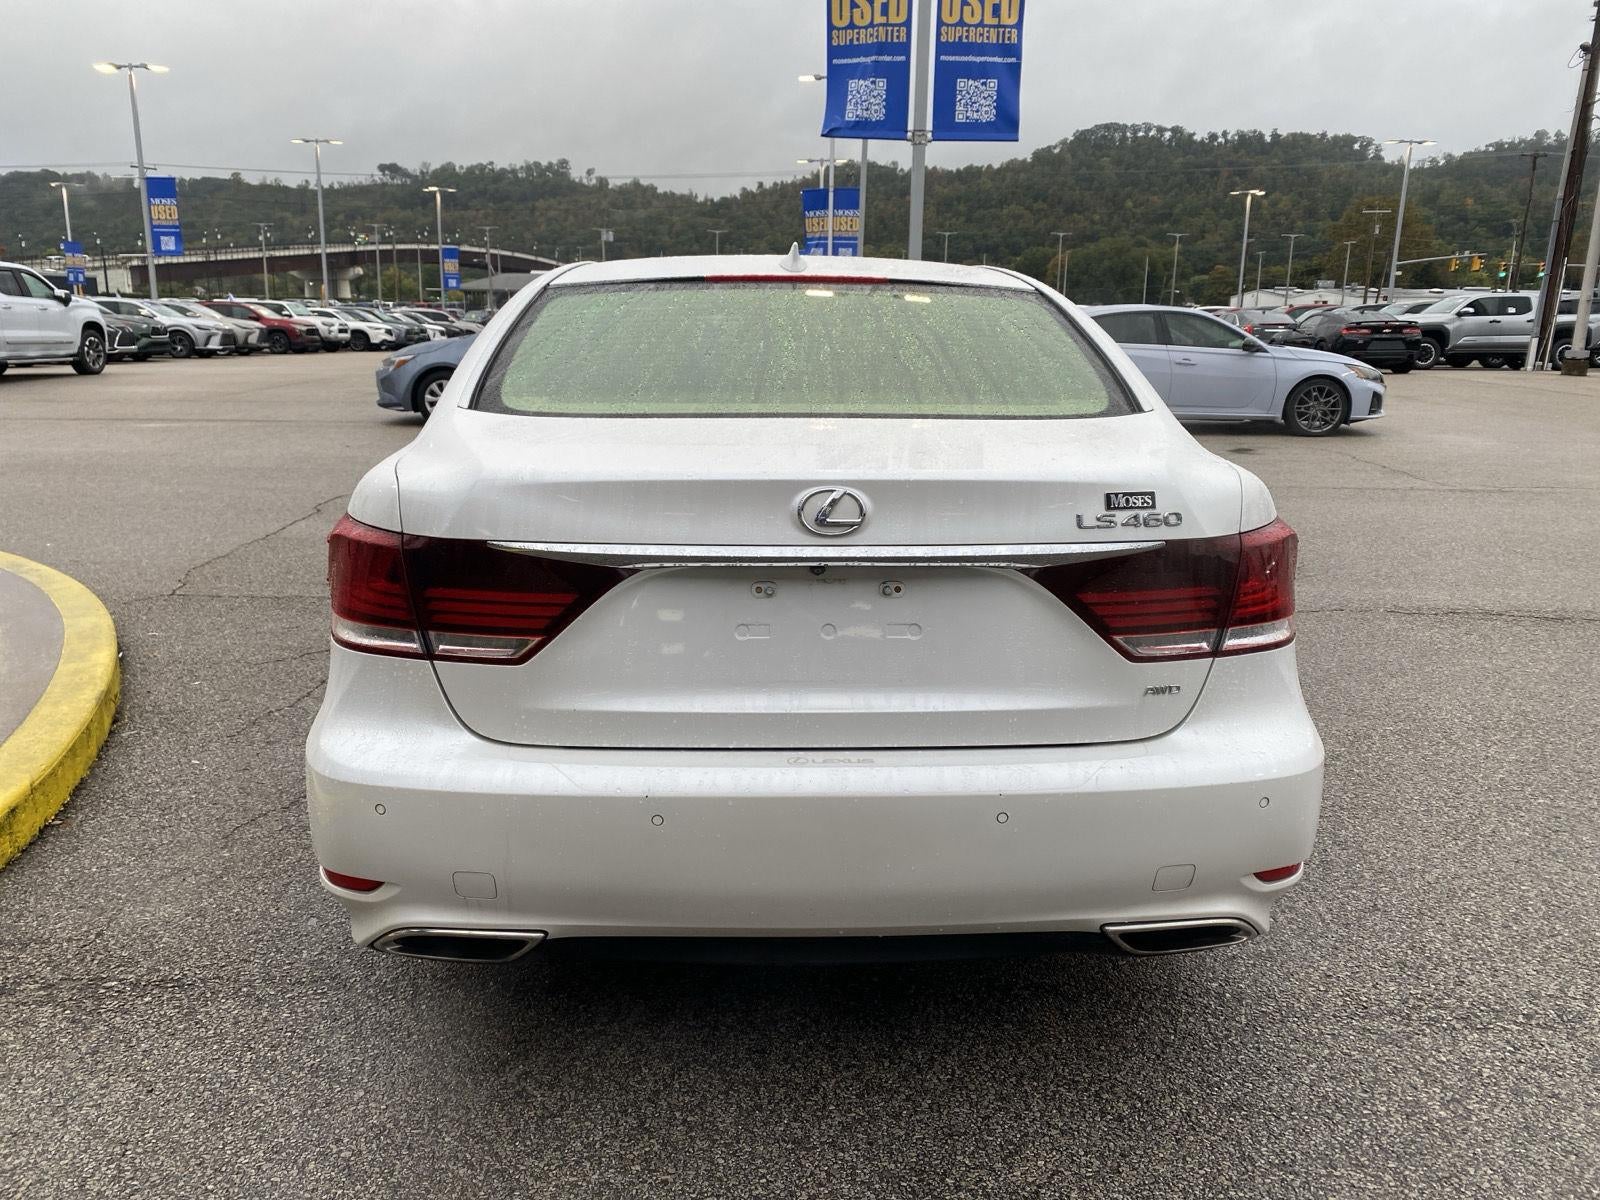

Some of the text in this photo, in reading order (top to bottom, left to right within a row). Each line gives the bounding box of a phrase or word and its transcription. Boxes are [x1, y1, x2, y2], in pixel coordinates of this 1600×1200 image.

[831, 0, 908, 27] USED
[941, 0, 1020, 25] USED
[832, 26, 907, 46] SUPERCENTER
[940, 26, 1018, 44] SUPERCENTER
[151, 205, 178, 220] USED
[833, 217, 860, 231] USED
[1076, 512, 1183, 529] LS 460
[1143, 685, 1181, 697] AWD
